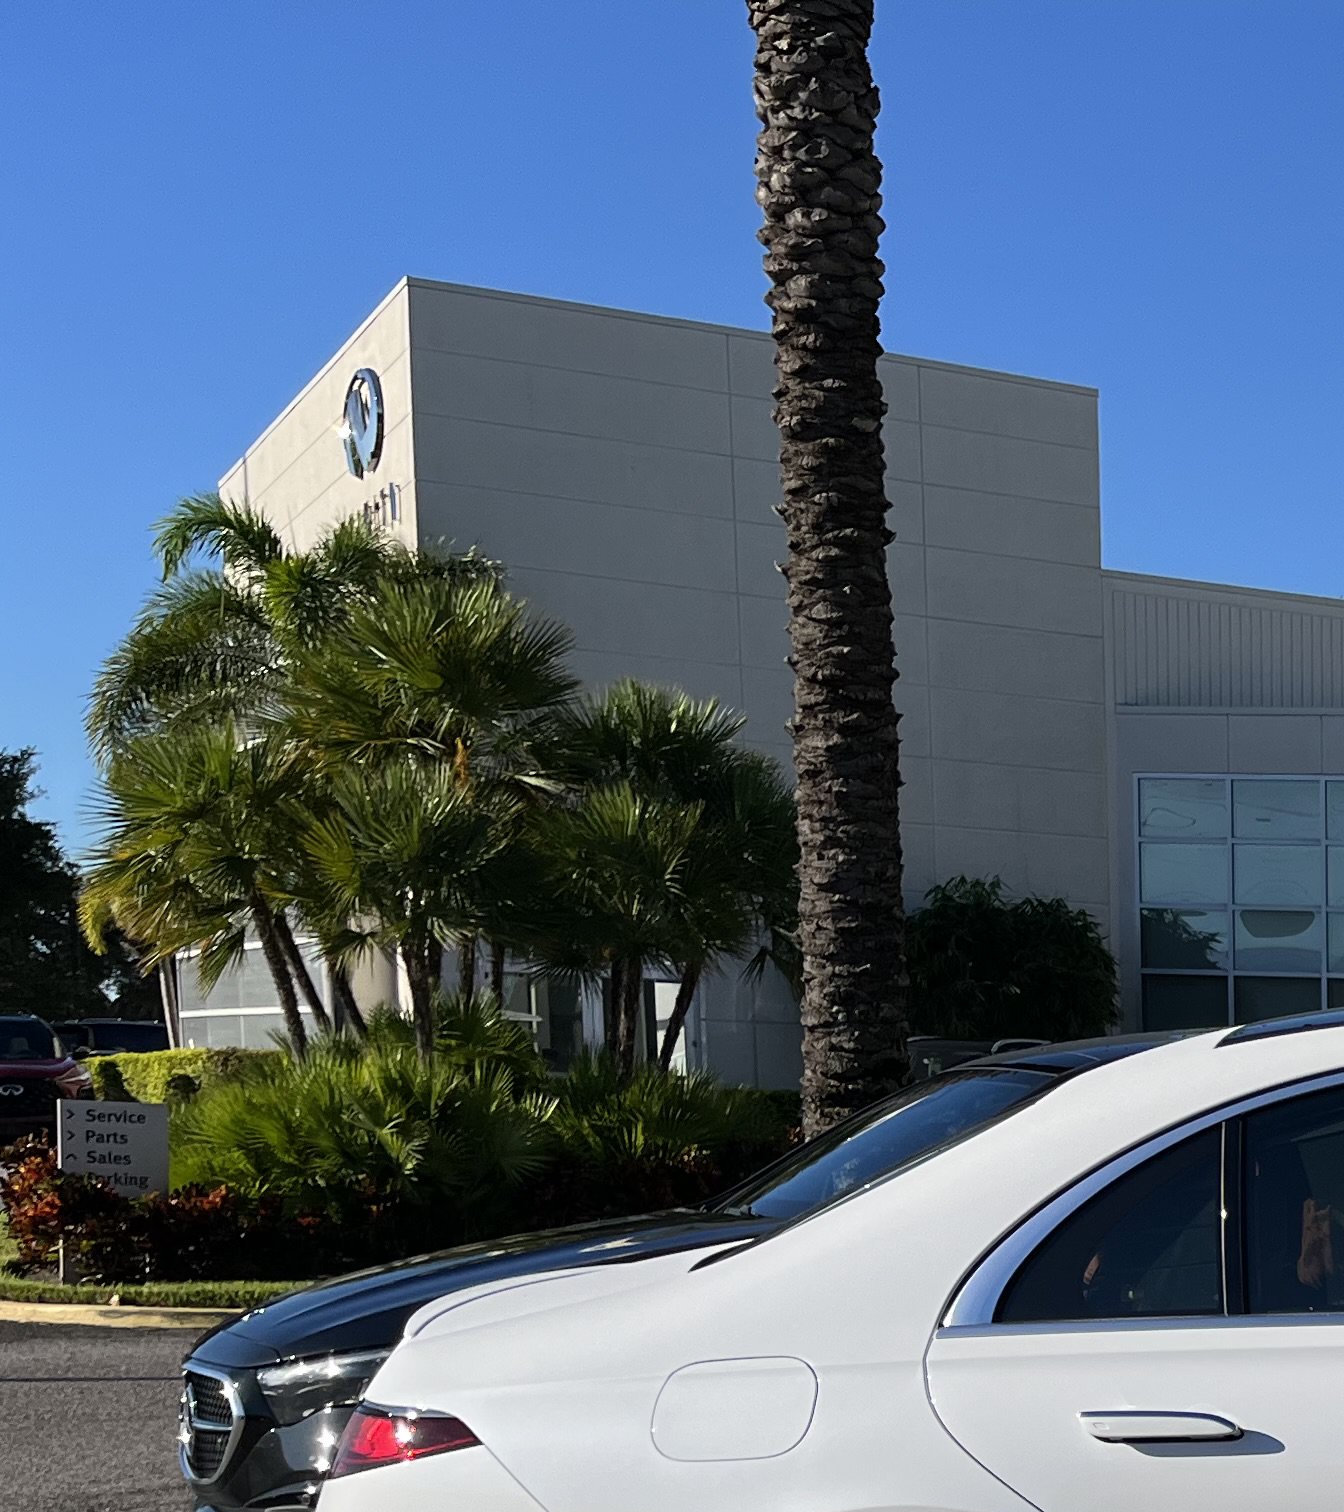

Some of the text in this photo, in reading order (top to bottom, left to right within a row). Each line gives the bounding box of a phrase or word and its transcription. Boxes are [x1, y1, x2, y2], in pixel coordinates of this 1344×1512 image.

[86, 1109, 146, 1124] Service
[86, 1130, 128, 1144] Parts
[87, 1150, 131, 1165] Sales
